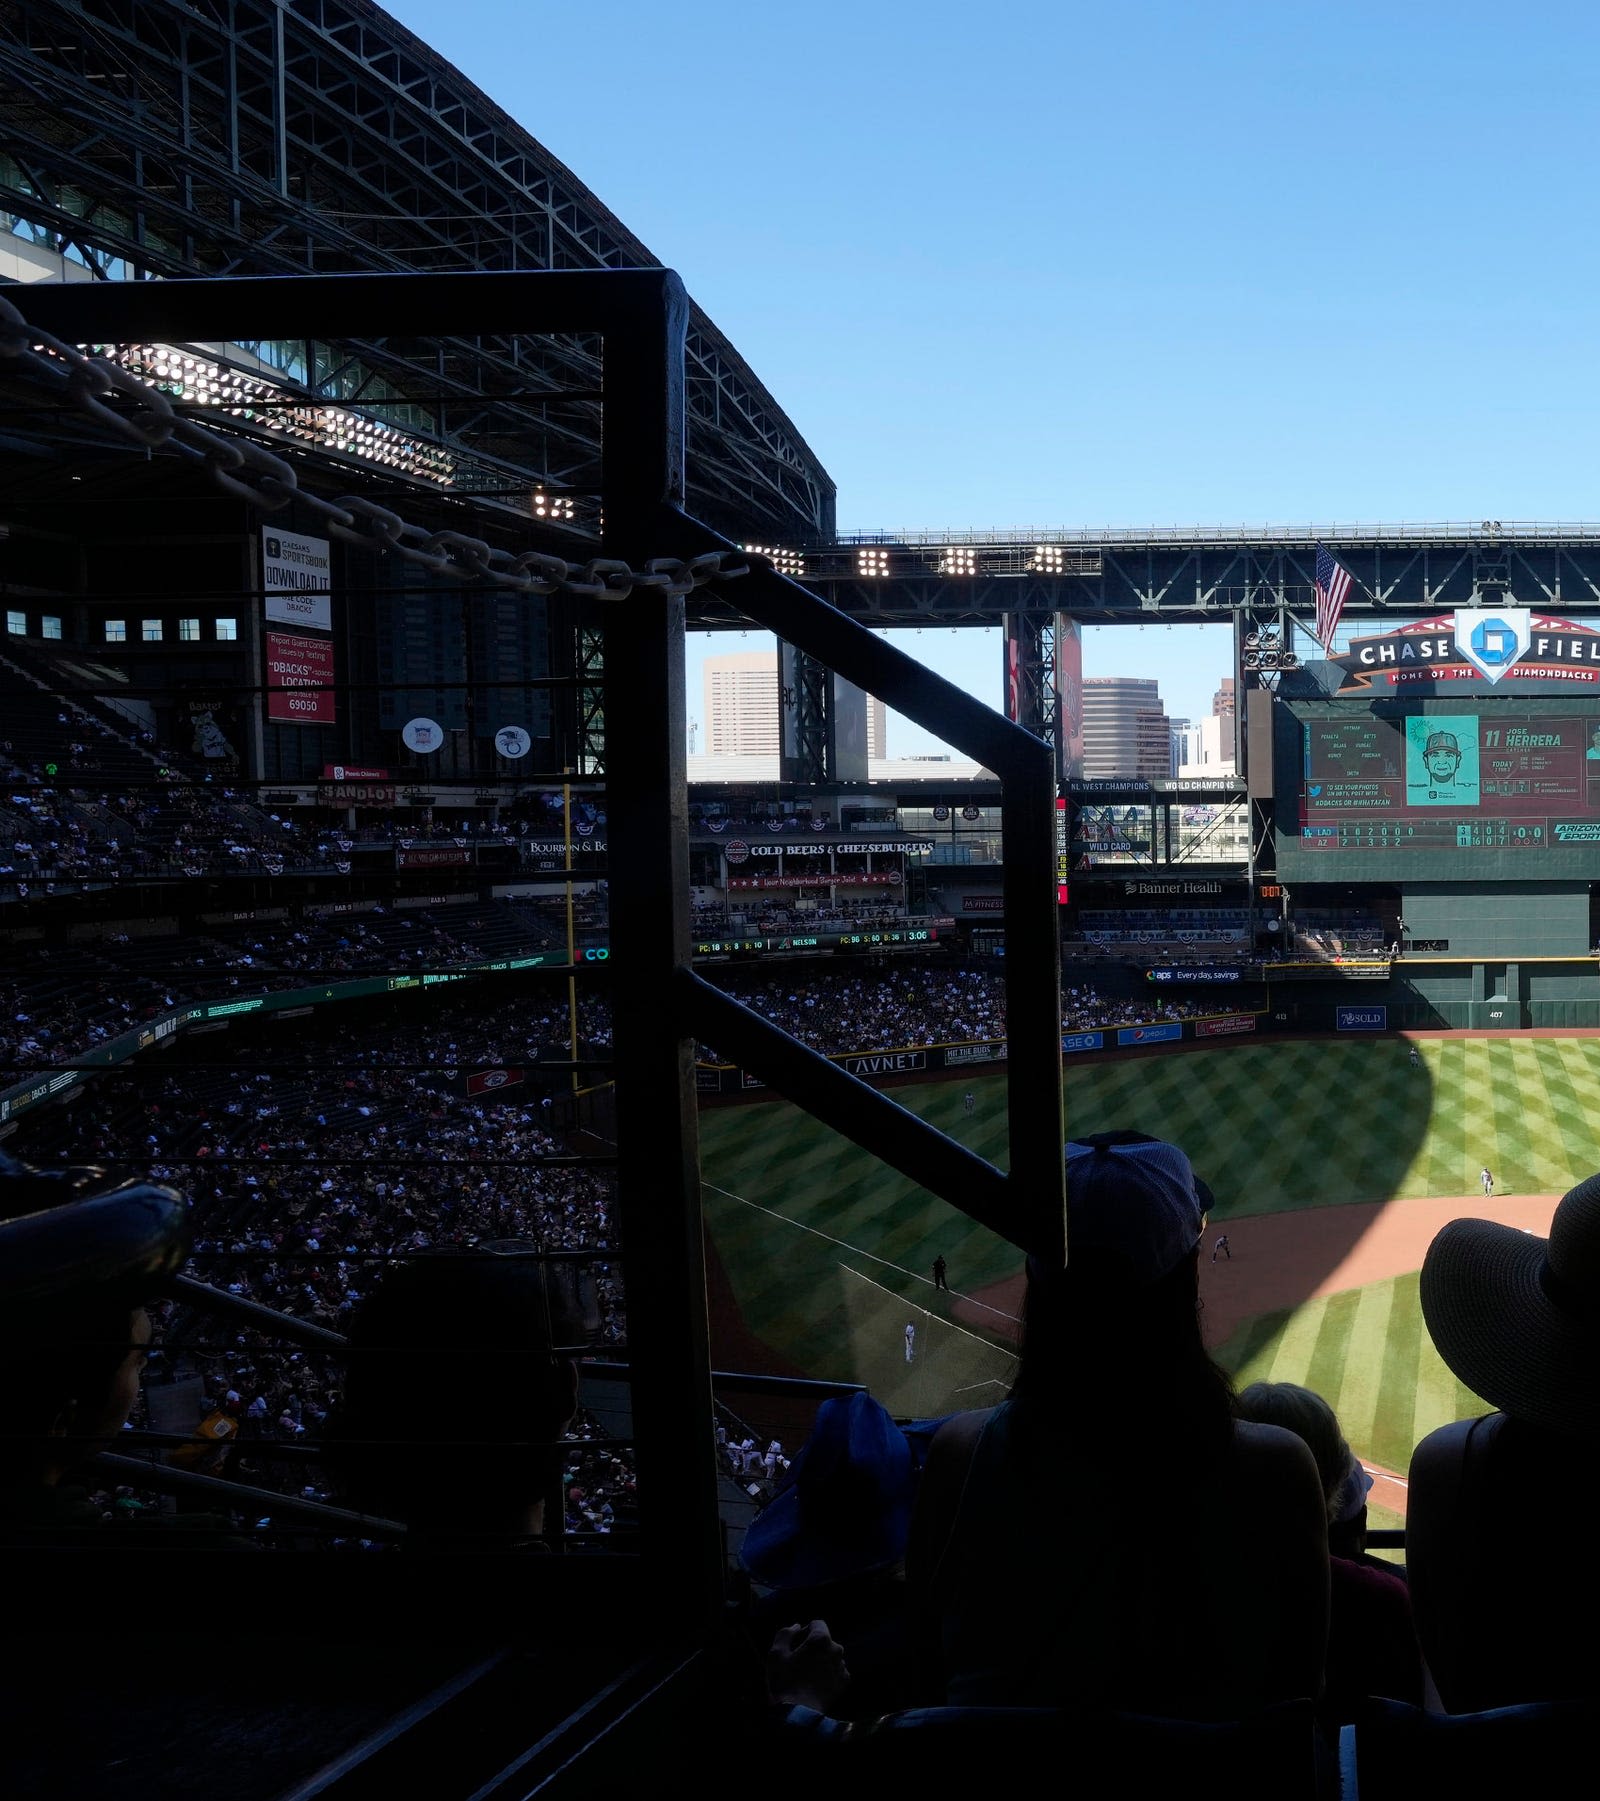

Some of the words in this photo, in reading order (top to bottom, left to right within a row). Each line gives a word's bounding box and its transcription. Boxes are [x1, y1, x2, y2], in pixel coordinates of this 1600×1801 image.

[282, 541, 310, 553] CAESARS
[282, 550, 328, 569] SPORTSBOOK
[266, 566, 317, 591] DOWNLOAD
[271, 635, 290, 646] Report
[291, 639, 308, 648] Guest
[309, 640, 332, 651] Conduct
[1359, 638, 1449, 665] CHASE
[1392, 671, 1424, 682] HOME
[1431, 669, 1445, 679] OF
[1452, 668, 1473, 678] THE
[1513, 668, 1593, 681] DIAMONDBACKS
[281, 675, 323, 687] LOCATION
[289, 698, 317, 712] 69050
[1485, 730, 1501, 747] 11
[1505, 735, 1561, 746] HERRERA
[1071, 783, 1080, 791] NL
[1082, 783, 1103, 791] WEST
[1105, 782, 1150, 791] CHAMPIONS
[1165, 781, 1190, 790] WORLD
[1191, 780, 1235, 789] CHAMPIONS
[324, 785, 394, 801] SANDLOT
[1486, 827, 1492, 836] 0
[1518, 827, 1526, 838] 0
[1533, 827, 1541, 838] 0
[581, 841, 591, 851] &
[1089, 842, 1108, 851] WILD
[1111, 842, 1131, 851] CARD
[1317, 839, 1328, 847] AZ
[1341, 838, 1347, 847] 2
[1368, 838, 1374, 847] 3
[1381, 838, 1387, 847] 3
[1394, 838, 1401, 847] 2
[1472, 837, 1481, 846] 16
[1486, 837, 1492, 846] 0
[750, 846, 783, 856] COLD
[786, 845, 824, 855] BEERS
[827, 845, 834, 854] &
[836, 842, 934, 853] CHEESEBURGERS
[780, 877, 818, 886] Neighborhood
[819, 876, 841, 885] Burger
[1139, 881, 1181, 894] Banner
[1183, 881, 1222, 893] Health
[1262, 886, 1280, 897] 0:07
[792, 938, 817, 946] NELSON
[871, 934, 880, 942] 60
[908, 931, 927, 940] 3:06
[699, 944, 710, 952] PC:
[711, 943, 720, 951] 18
[753, 941, 762, 949] 10
[1156, 972, 1172, 981] aps
[1177, 971, 1197, 981] Every
[1198, 971, 1212, 981] day,
[1213, 972, 1239, 981] savings
[1144, 1029, 1167, 1039] pepsi
[856, 1053, 918, 1073] AVNET
